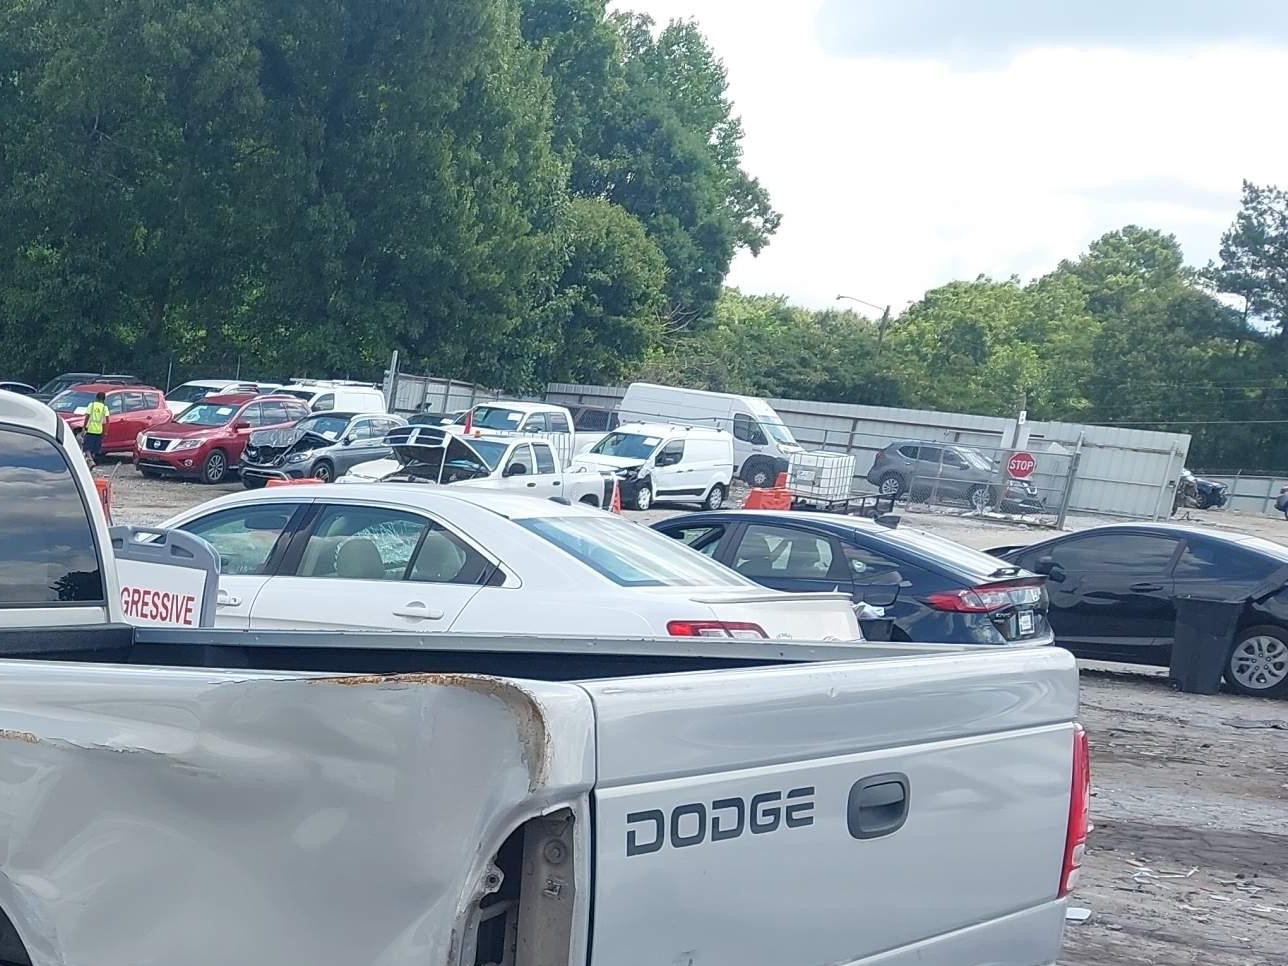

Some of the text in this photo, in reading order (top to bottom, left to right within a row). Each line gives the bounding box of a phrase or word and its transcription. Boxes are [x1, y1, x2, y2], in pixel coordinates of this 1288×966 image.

[1010, 460, 1033, 471] STOP
[120, 587, 195, 625] GRESSIVE
[626, 786, 815, 857] DODGE
